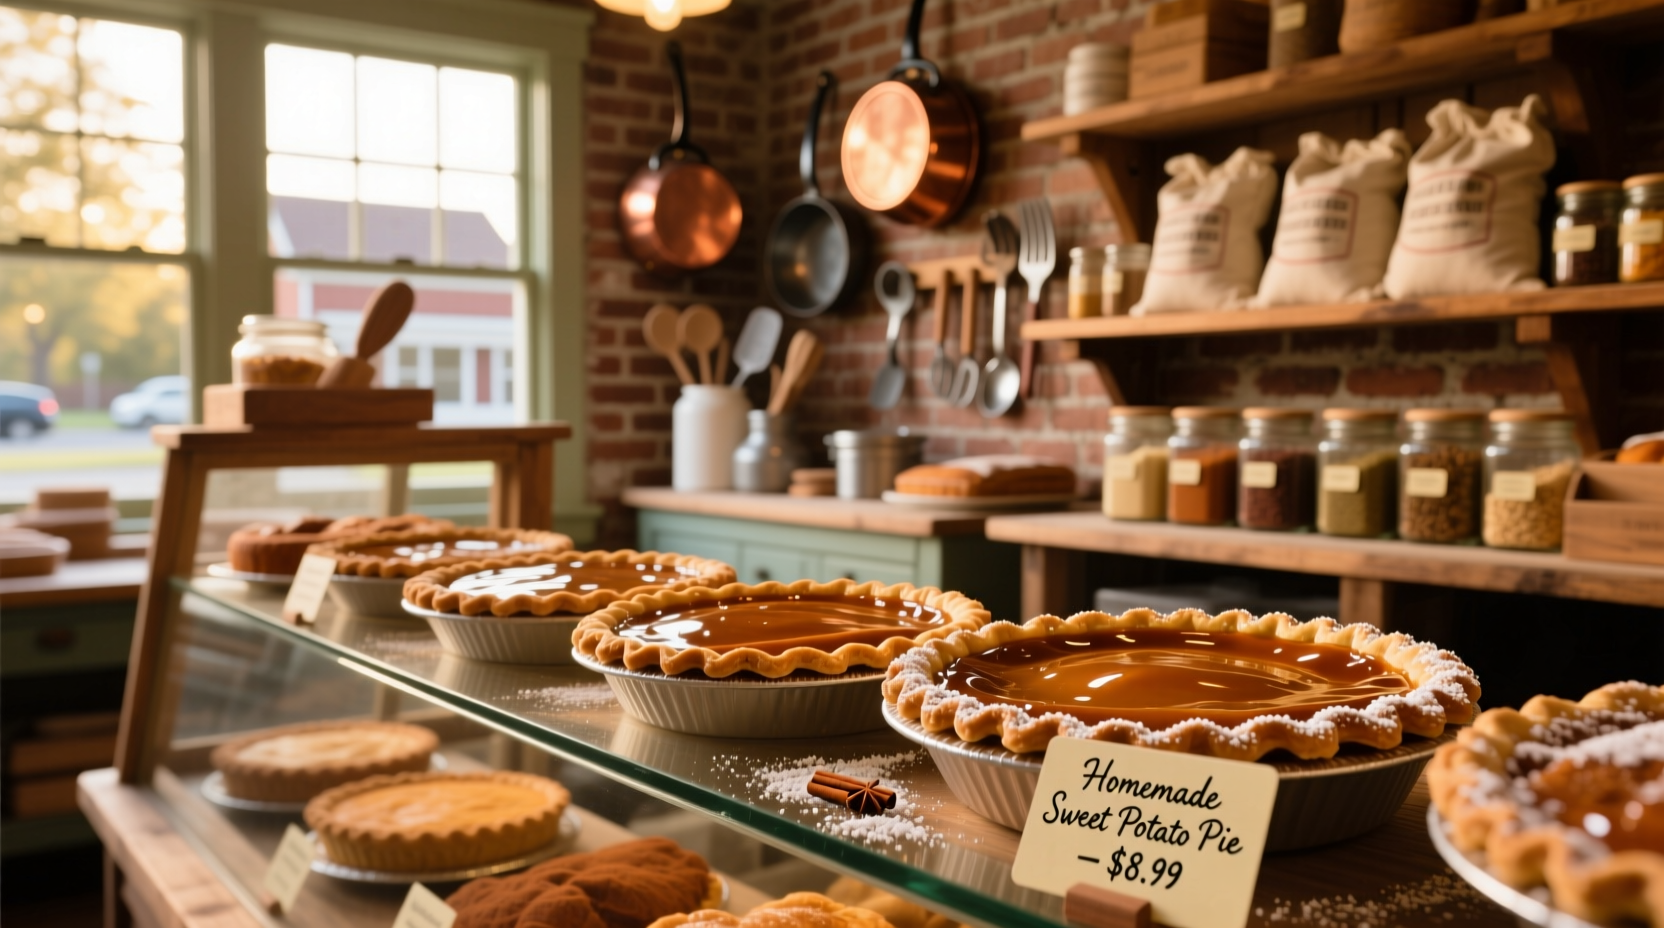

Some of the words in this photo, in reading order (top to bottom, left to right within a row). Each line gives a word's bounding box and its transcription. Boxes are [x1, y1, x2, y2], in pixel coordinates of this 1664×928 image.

[1082, 757, 1223, 811] Homemade
[1042, 790, 1114, 832] Sweet
[1117, 805, 1191, 847] Potato
[1198, 818, 1244, 855] Pie
[1106, 845, 1184, 890] $8.99
